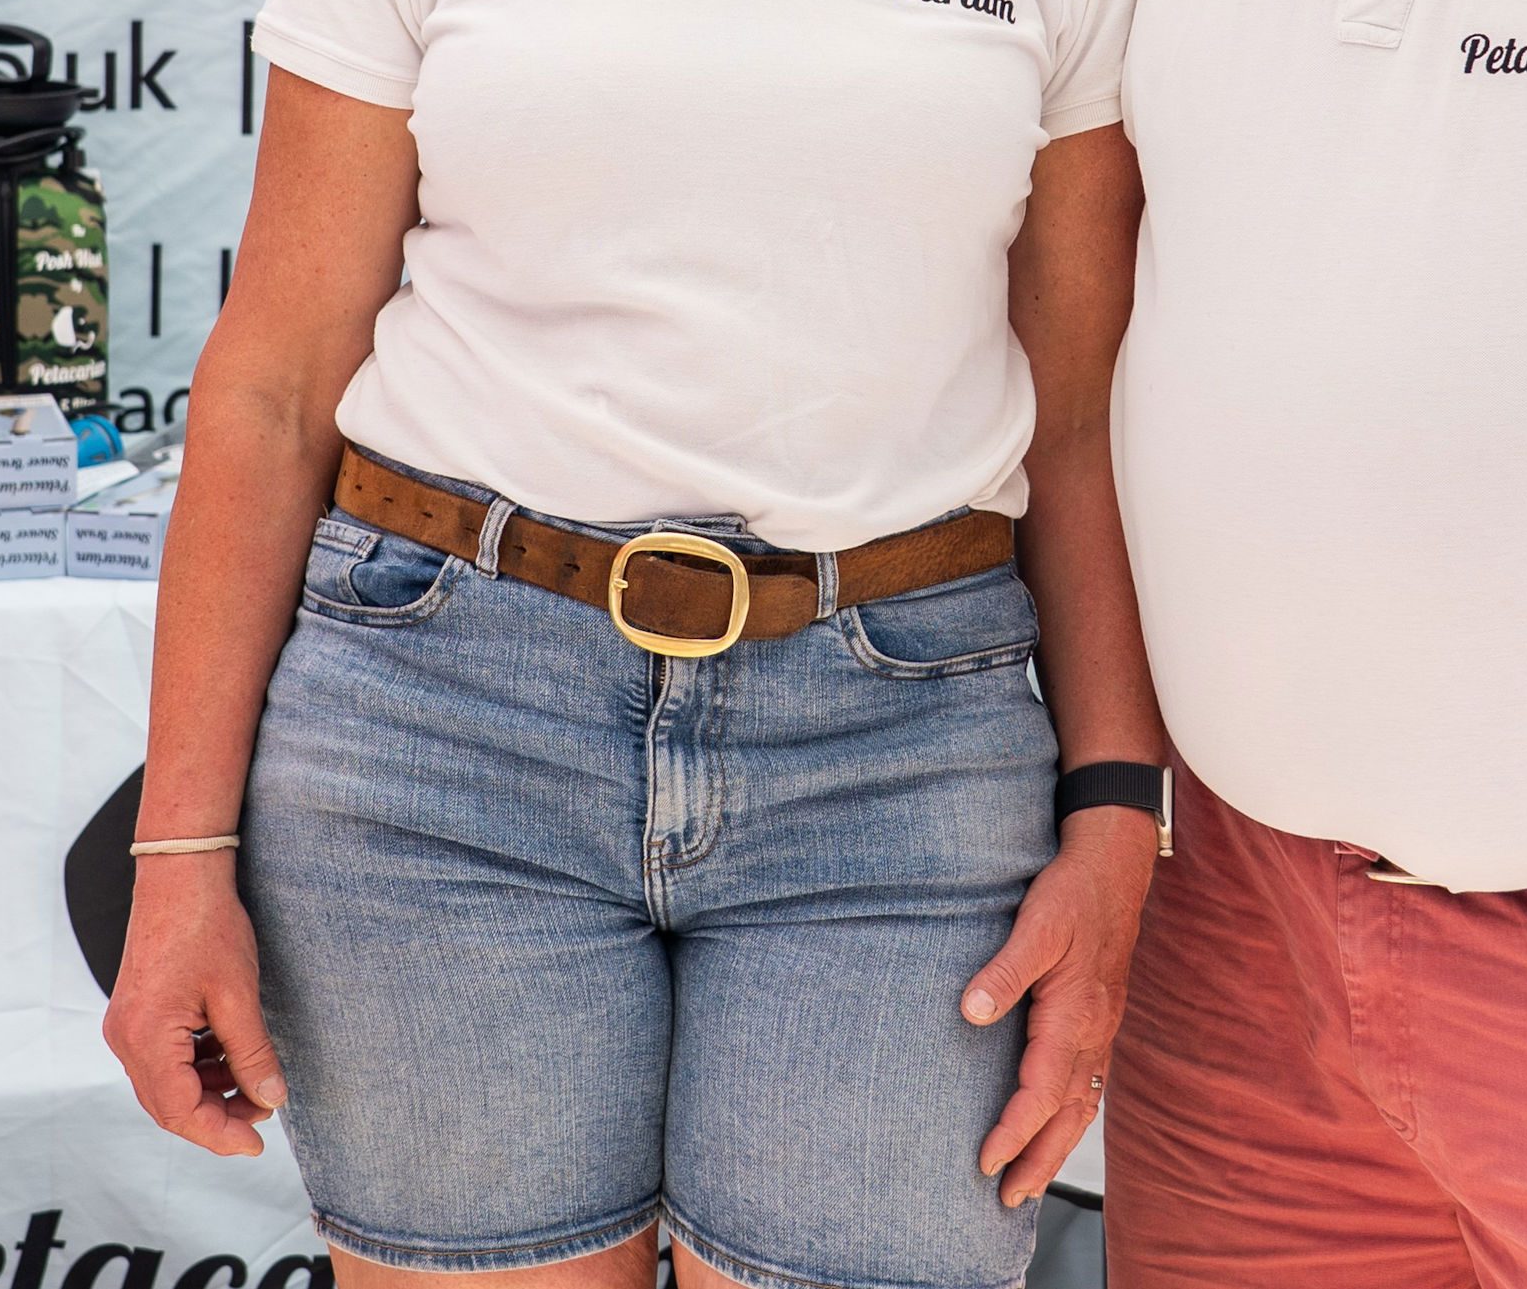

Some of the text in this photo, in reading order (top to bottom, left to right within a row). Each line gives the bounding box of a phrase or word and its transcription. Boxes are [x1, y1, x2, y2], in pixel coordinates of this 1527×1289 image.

[27, 455, 71, 468] Shower
[16, 527, 59, 540] Shower
[75, 527, 153, 546] Shower Brush
